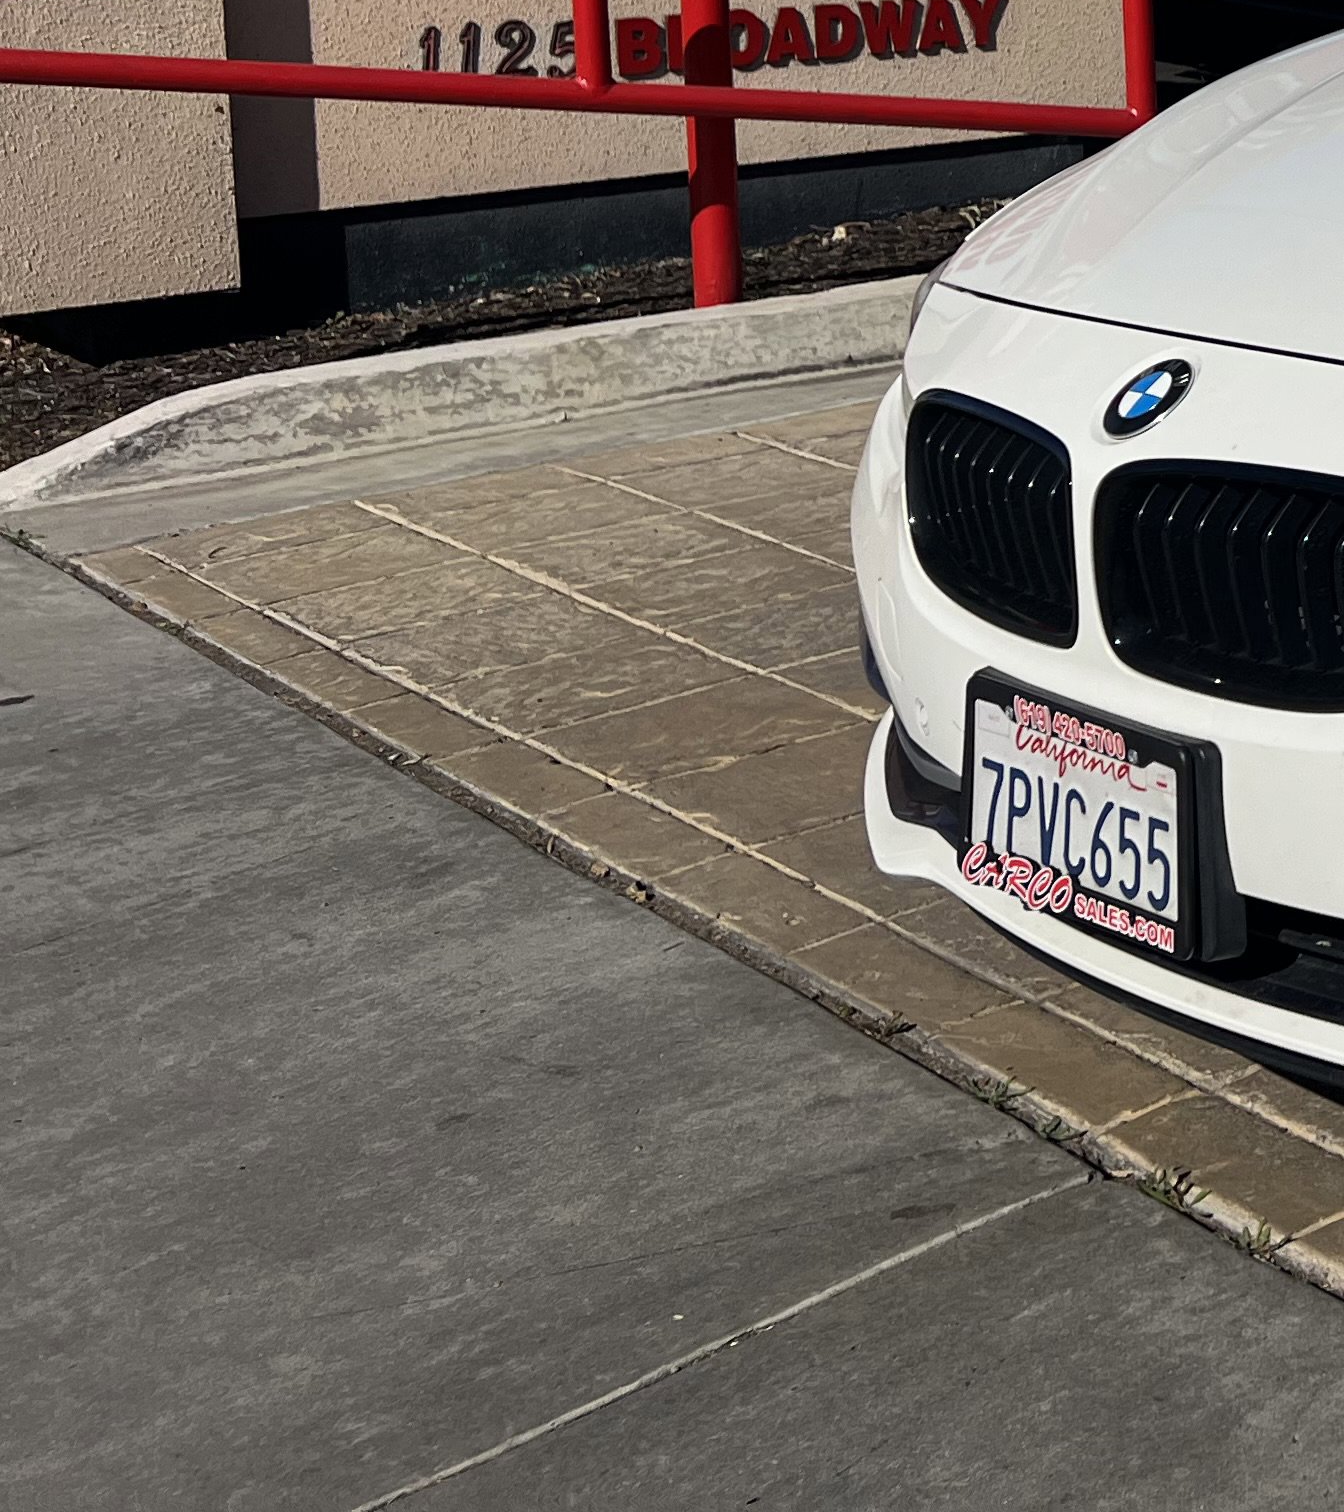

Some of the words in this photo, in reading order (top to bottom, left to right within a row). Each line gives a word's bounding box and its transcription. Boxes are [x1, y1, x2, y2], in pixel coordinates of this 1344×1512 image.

[420, 19, 577, 81] 1125
[982, 756, 1171, 912] 7PVC655
[1074, 893, 1175, 953] SALES.COM
